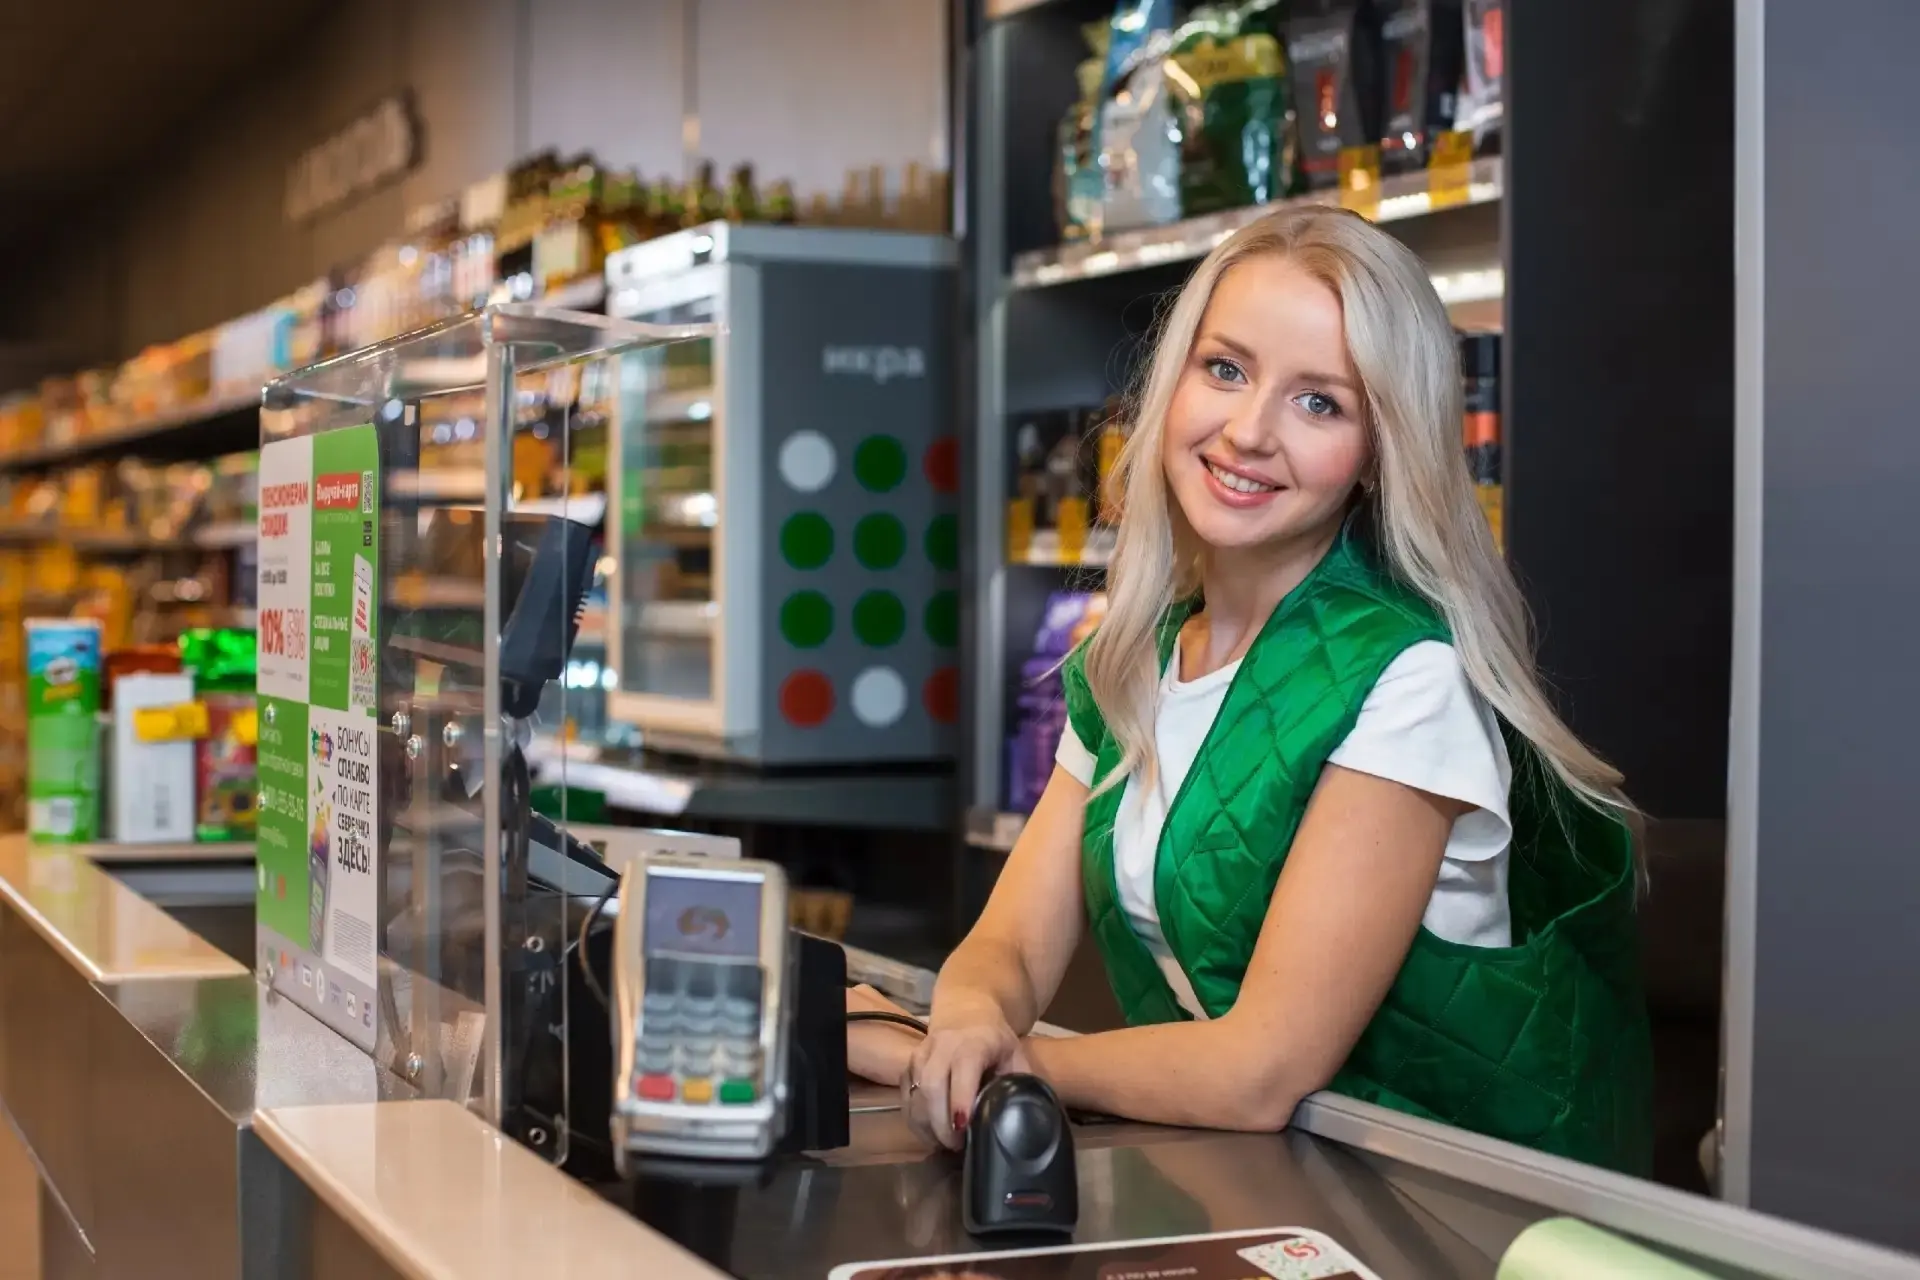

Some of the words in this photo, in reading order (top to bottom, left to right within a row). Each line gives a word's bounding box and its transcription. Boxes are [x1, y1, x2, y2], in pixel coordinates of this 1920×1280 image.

[823, 345, 925, 384] икра
[316, 479, 359, 505] Выручай-карта
[260, 609, 285, 655] 10%
[337, 726, 371, 759] БОНУСЫ
[337, 757, 371, 785] СПАСИБО
[337, 784, 348, 807] ПО
[350, 787, 371, 815] КАРТЕ
[337, 836, 371, 876] ЗДЕСЬ!
